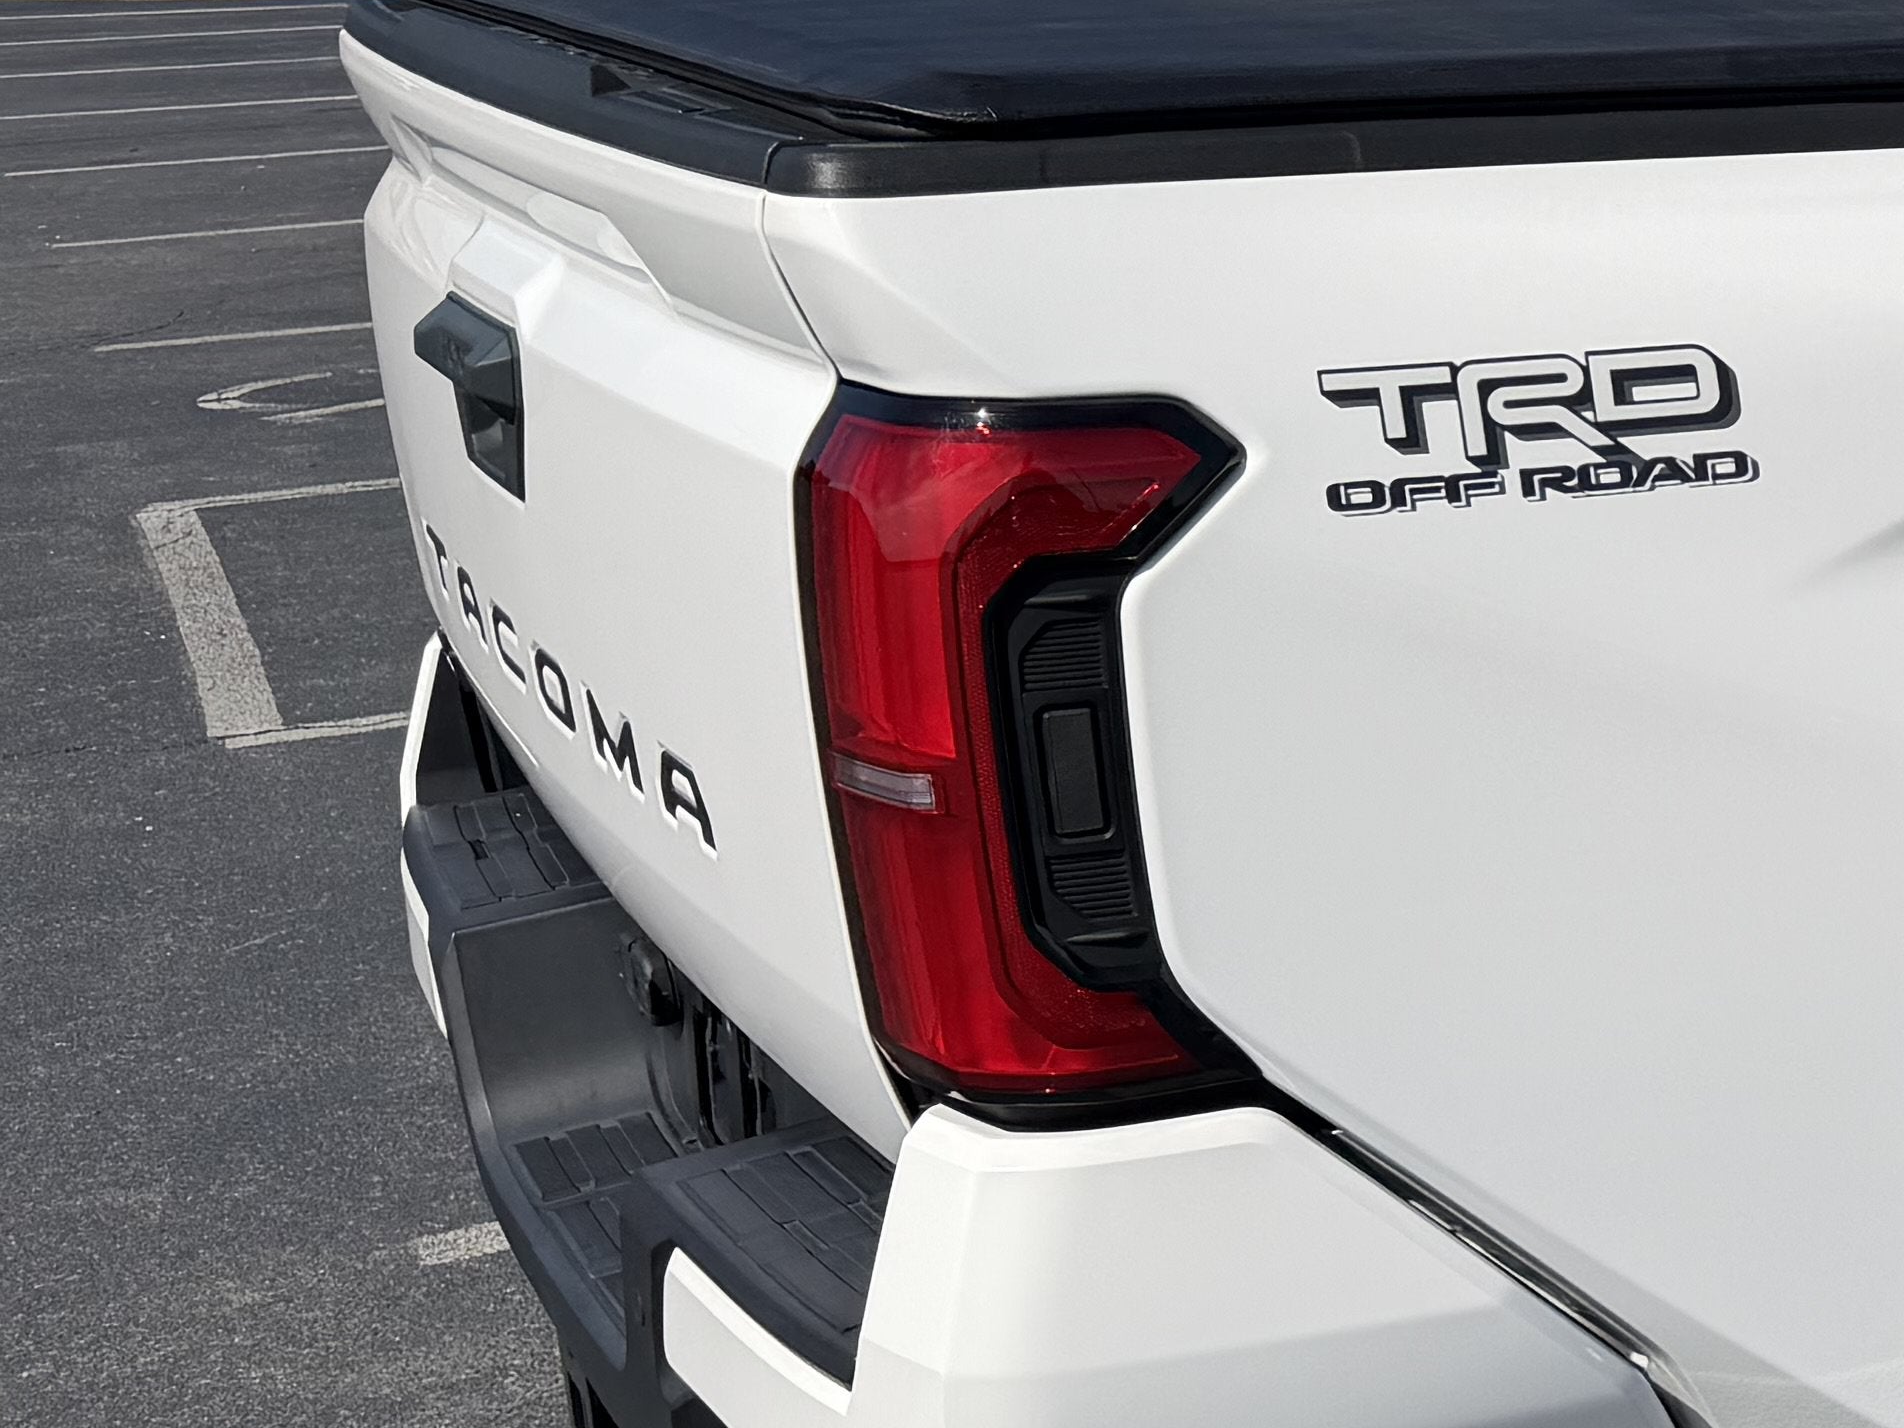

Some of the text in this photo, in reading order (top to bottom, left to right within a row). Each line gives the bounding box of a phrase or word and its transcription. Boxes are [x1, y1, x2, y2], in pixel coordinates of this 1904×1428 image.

[1316, 343, 1742, 471] TRD
[1325, 449, 1761, 517] OFF ROAD
[424, 521, 719, 856] TACOMA
